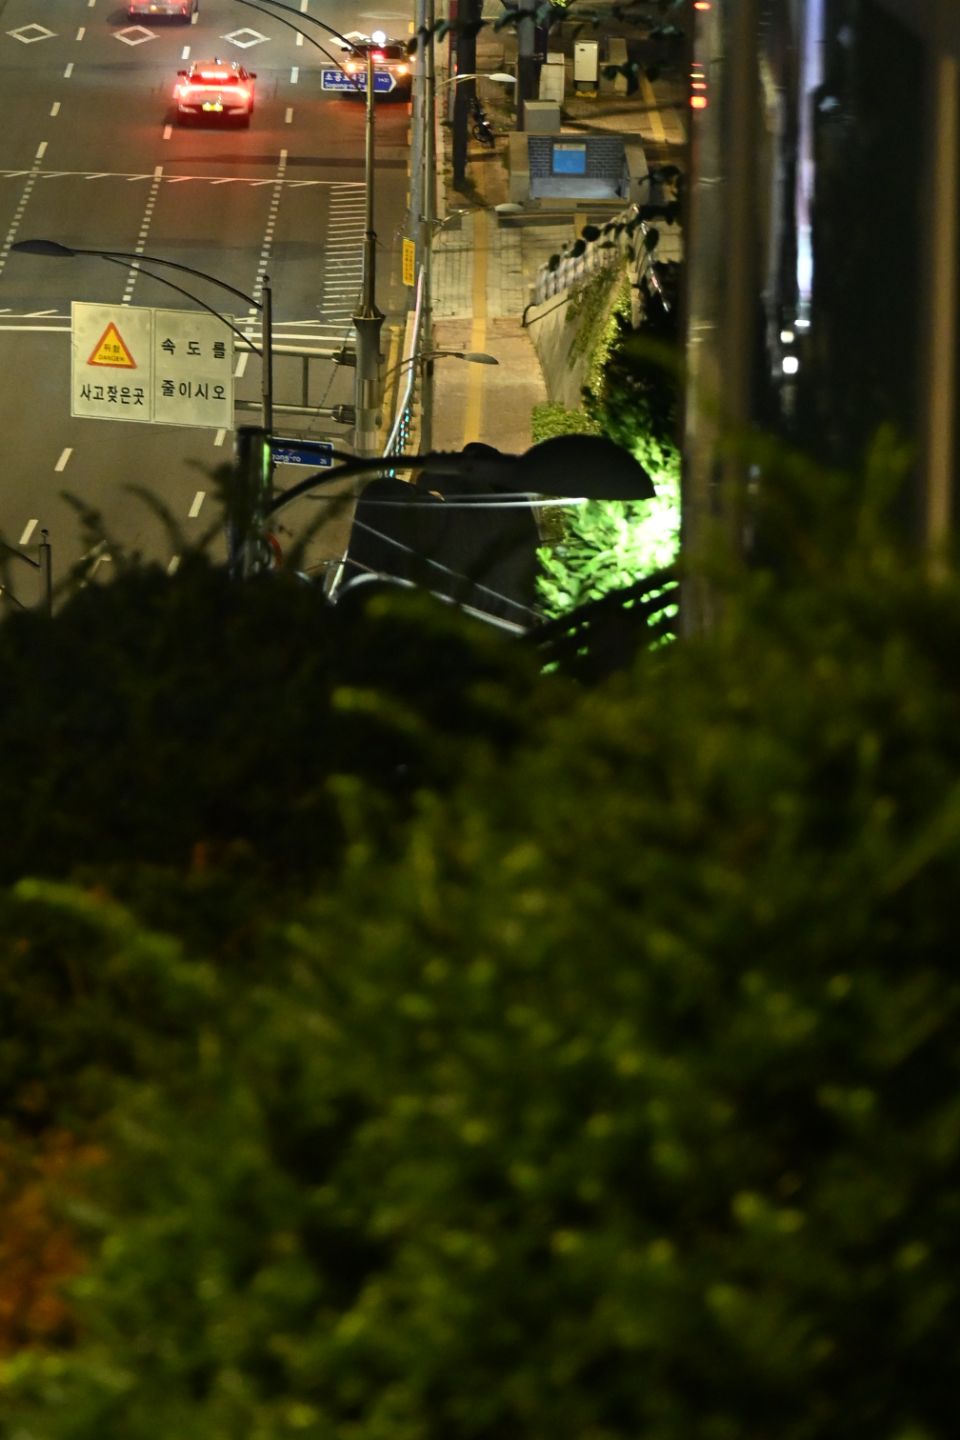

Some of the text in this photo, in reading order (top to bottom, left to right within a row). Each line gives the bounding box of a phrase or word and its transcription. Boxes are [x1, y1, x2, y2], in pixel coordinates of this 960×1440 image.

[103, 343, 121, 353] 위험
[161, 338, 226, 360] 속도를
[80, 383, 145, 406] 사고잦은곳
[161, 379, 227, 401] 줄이시오
